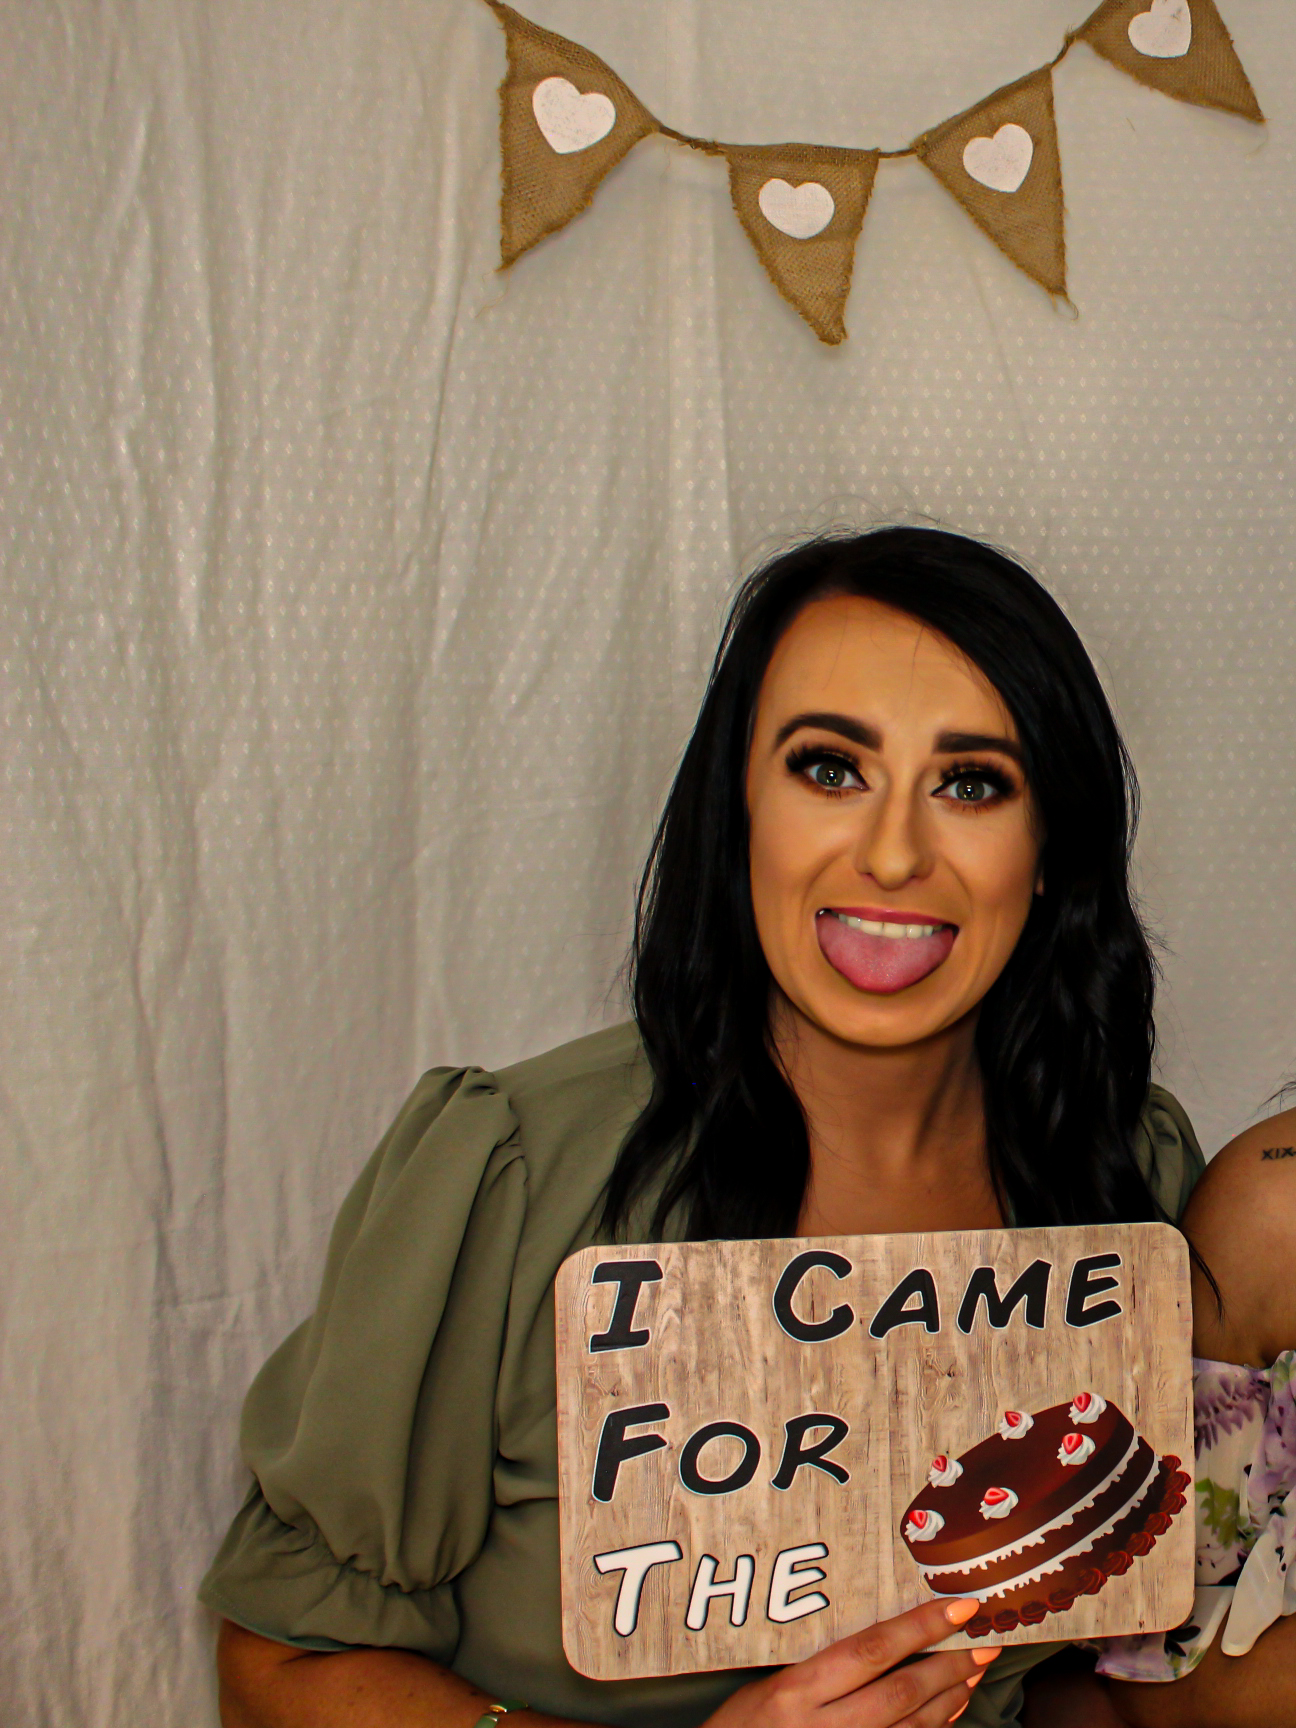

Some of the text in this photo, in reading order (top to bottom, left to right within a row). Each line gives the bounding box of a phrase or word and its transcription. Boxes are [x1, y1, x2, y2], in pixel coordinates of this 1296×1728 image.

[589, 1250, 1123, 1354] I CAME
[592, 1403, 851, 1503] FOR
[594, 1540, 830, 1637] THE
